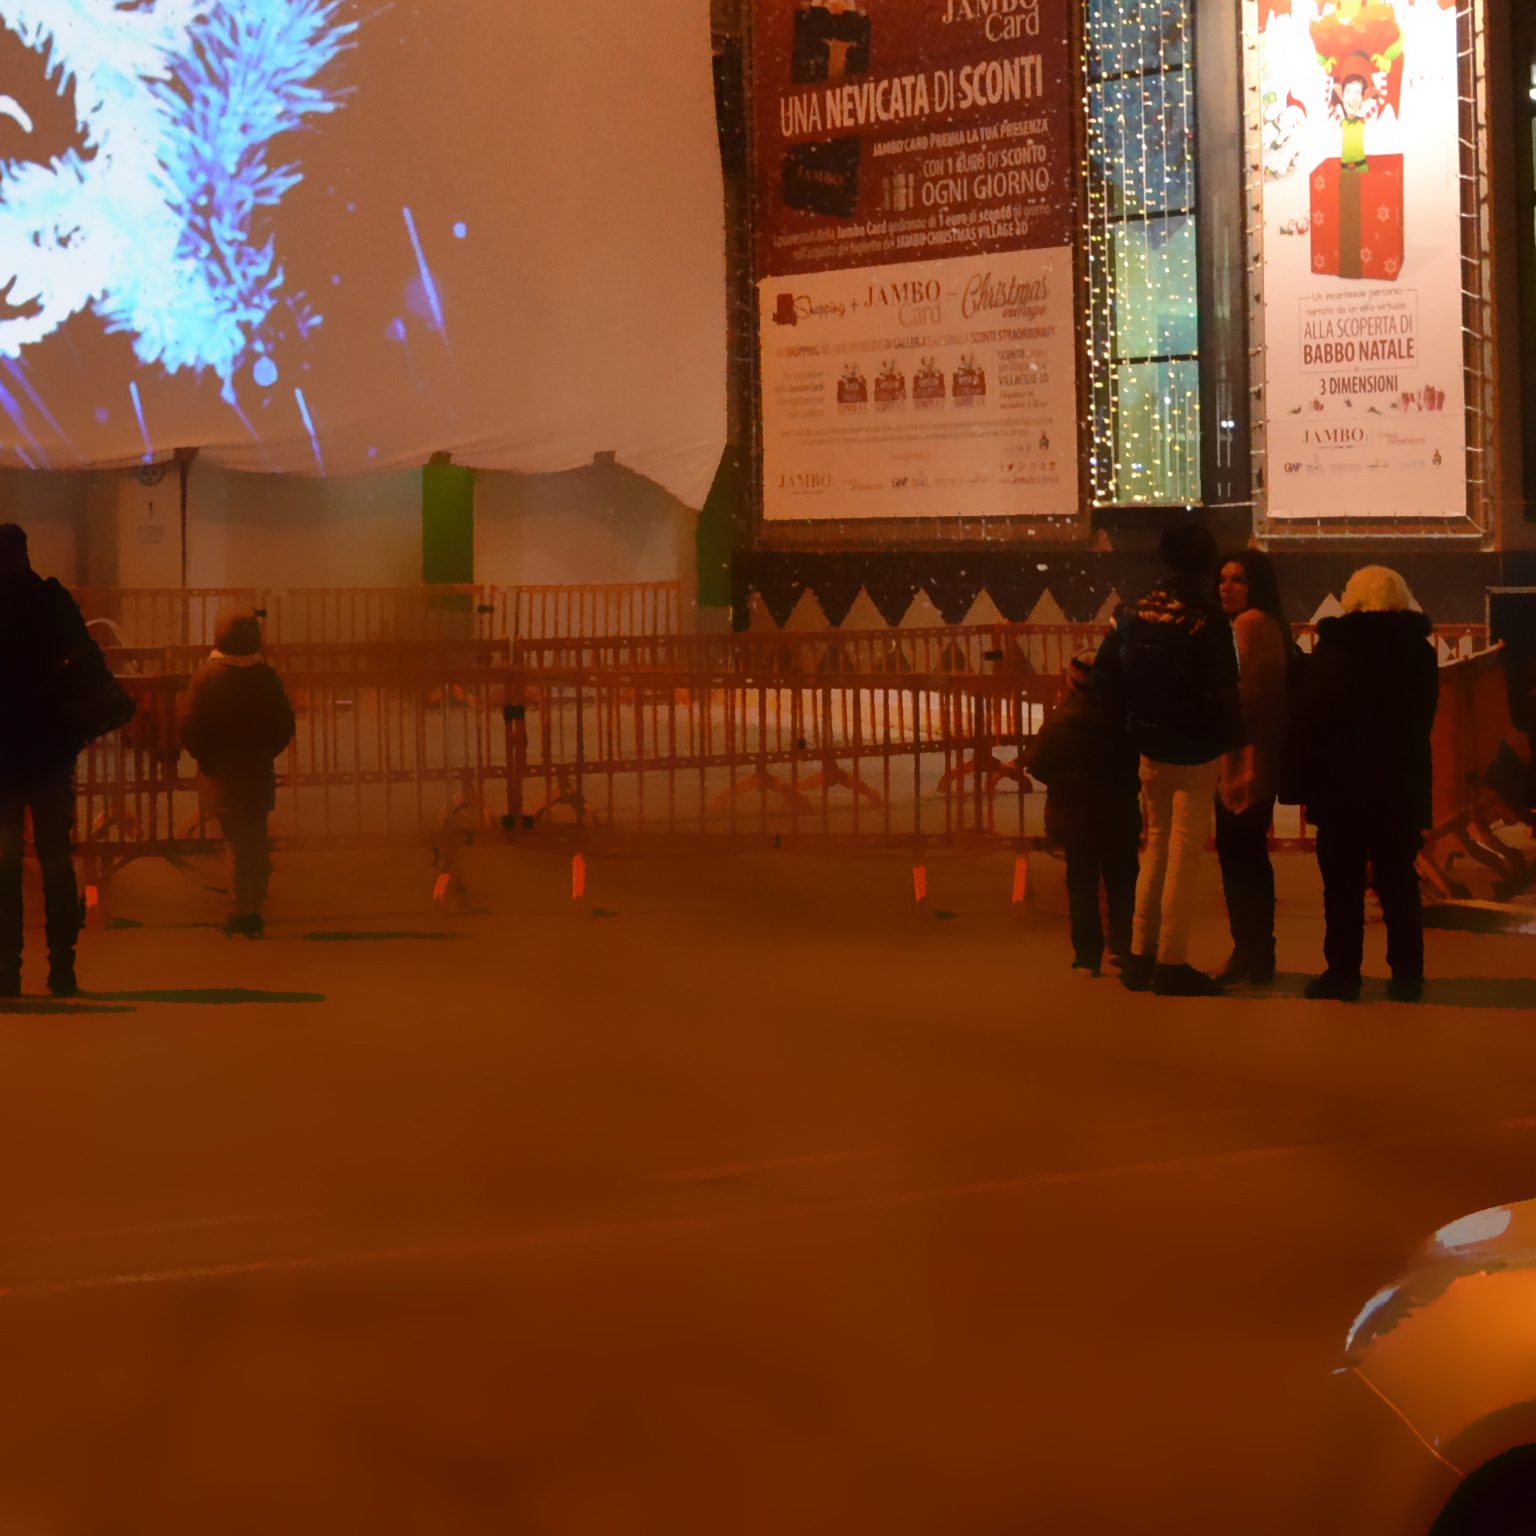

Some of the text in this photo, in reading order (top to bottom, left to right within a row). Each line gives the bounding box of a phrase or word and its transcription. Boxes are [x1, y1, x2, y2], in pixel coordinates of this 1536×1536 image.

[985, 4, 1039, 42] Card
[780, 54, 1042, 137] UNA NEVICATA DI SCONTI
[873, 118, 1049, 157] JAMBO CARD PREMIA LA TUA PRESENZA
[923, 144, 1046, 177] CON 1 EURO DI SCONTO
[922, 167, 1049, 206] OGNI GIORNO
[866, 220, 887, 236] Card
[977, 223, 1013, 240] VILLAGE
[793, 295, 845, 319] Shopping
[865, 279, 941, 308] JAMBO
[961, 271, 1051, 320] Christmas
[1369, 287, 1403, 301] percorso
[898, 302, 942, 328] Card
[1336, 305, 1346, 315] da
[1348, 305, 1358, 313] un
[970, 330, 996, 344] SCONTI
[1304, 314, 1413, 340] ALLA SCOPERTA DI
[1303, 337, 1415, 365] BABBO NATALE
[1320, 375, 1398, 396] 3 DIMENSIONI
